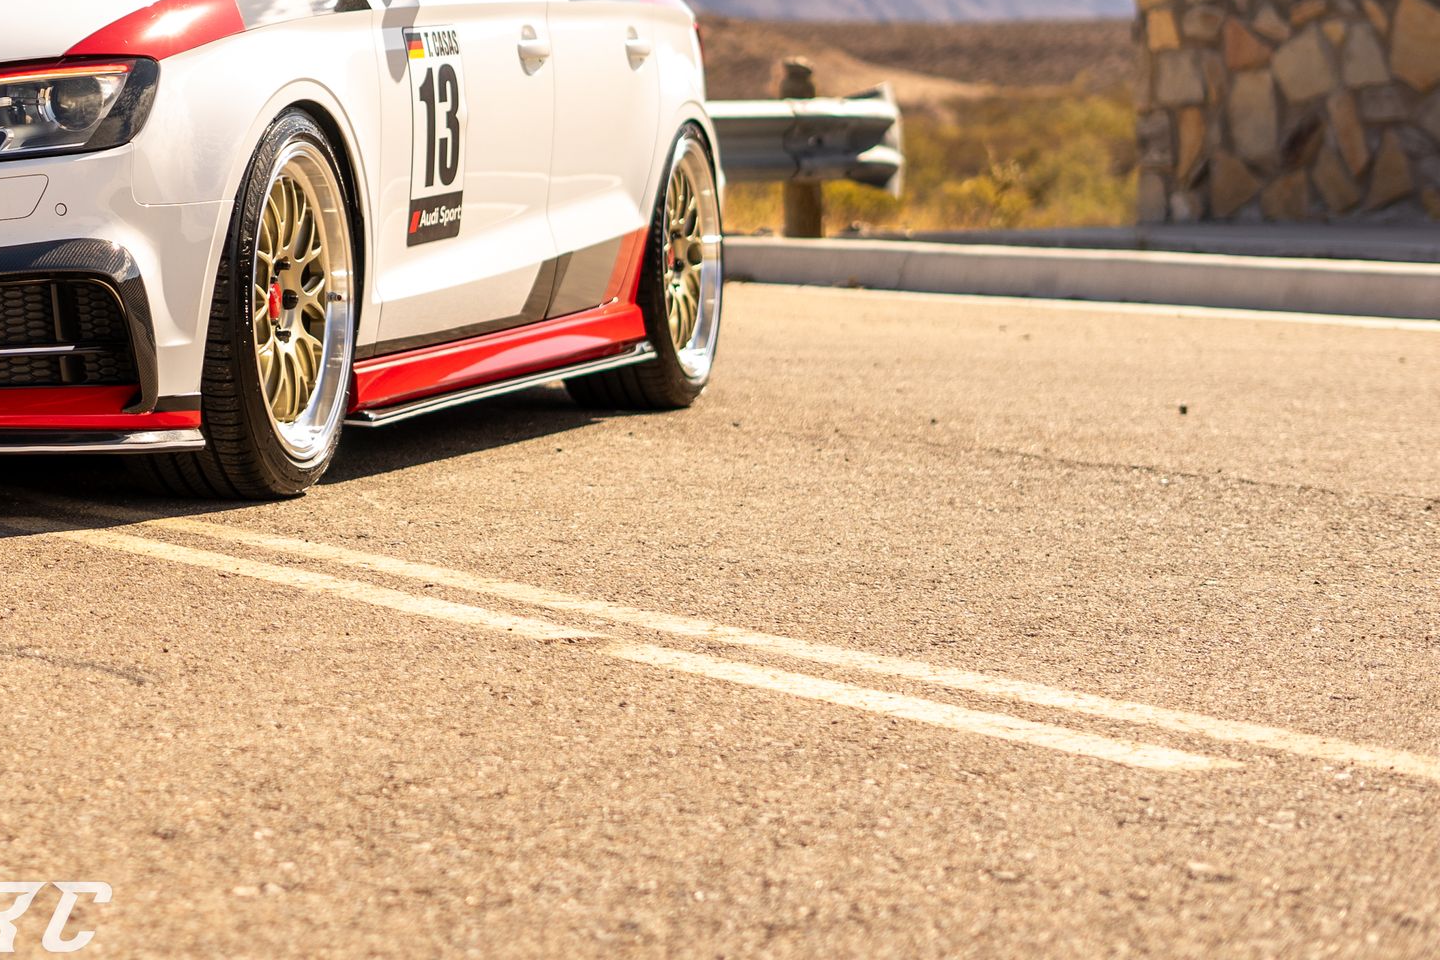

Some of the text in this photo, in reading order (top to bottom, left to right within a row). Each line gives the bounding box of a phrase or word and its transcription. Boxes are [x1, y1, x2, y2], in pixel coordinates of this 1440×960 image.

[424, 30, 460, 57] T. CASAS
[419, 63, 461, 188] 13
[418, 204, 462, 228] Audi Sport
